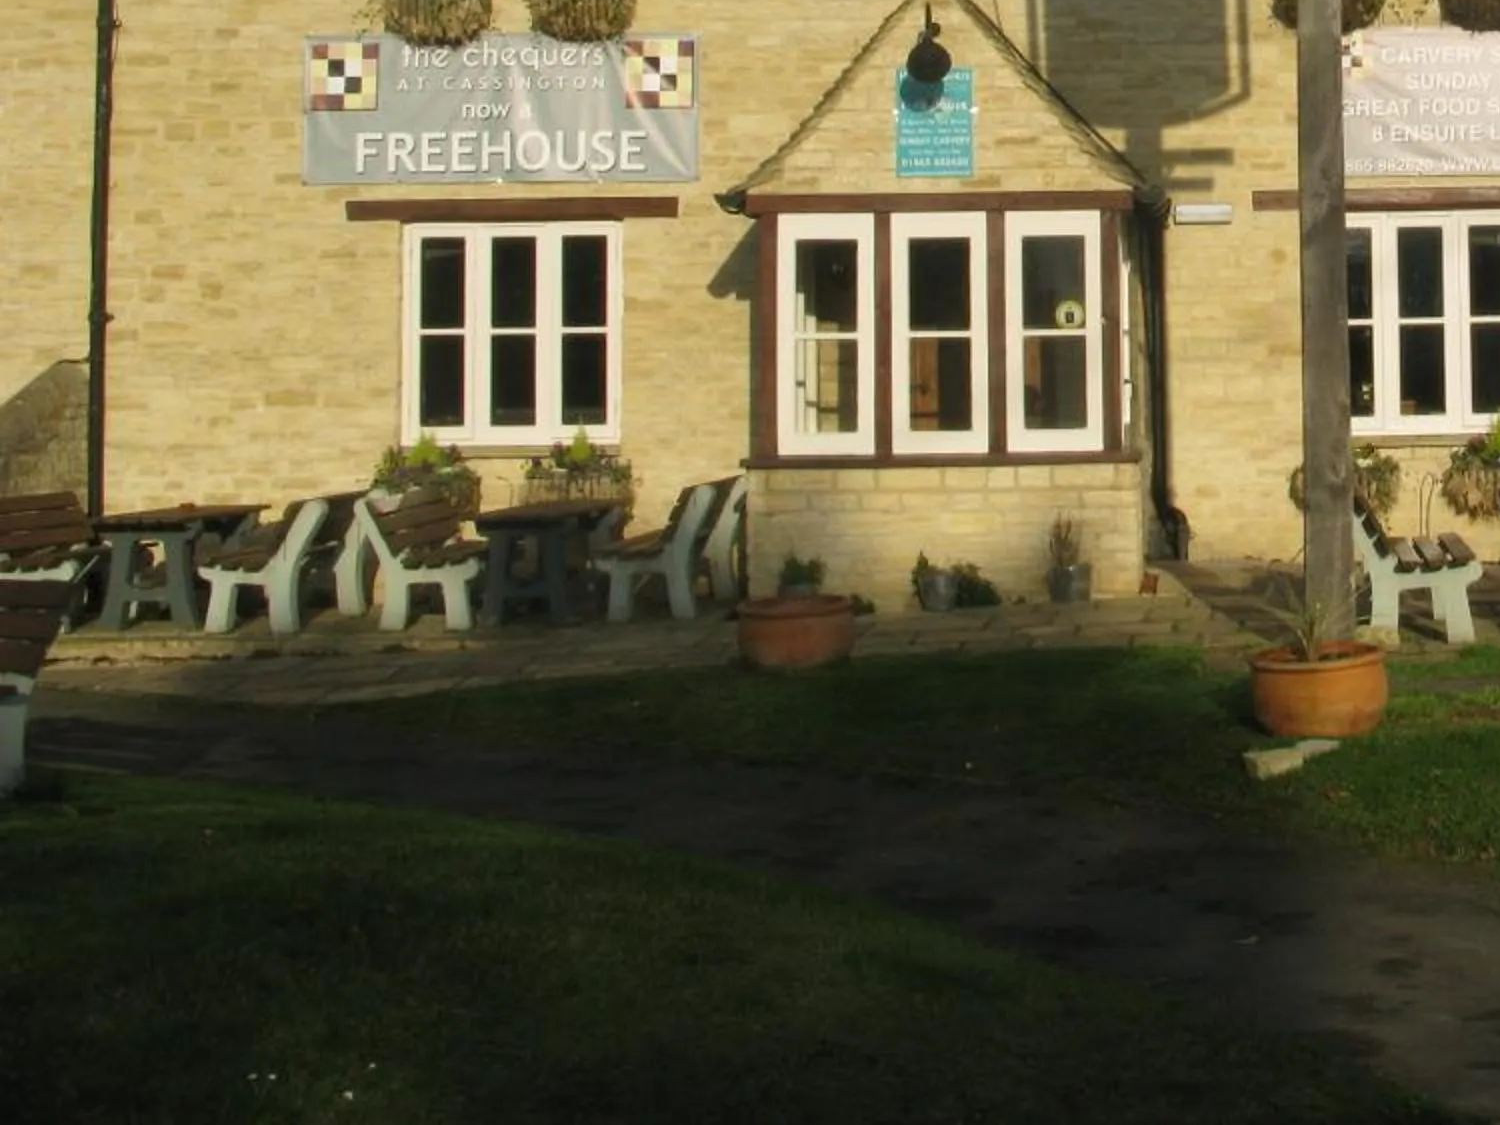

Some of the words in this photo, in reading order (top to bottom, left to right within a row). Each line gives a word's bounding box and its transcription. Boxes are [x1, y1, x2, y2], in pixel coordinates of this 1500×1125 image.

[401, 45, 450, 69] the
[462, 39, 604, 71] chequers
[1381, 45, 1484, 65] CARVERY
[443, 75, 607, 91] CASSINGTON
[1405, 72, 1492, 92] SUNDAY
[462, 101, 510, 121] now
[519, 104, 532, 119] a
[1419, 97, 1481, 117] FOOD
[1391, 124, 1483, 143] ENSUITE
[354, 130, 648, 175] FREEHOUSE
